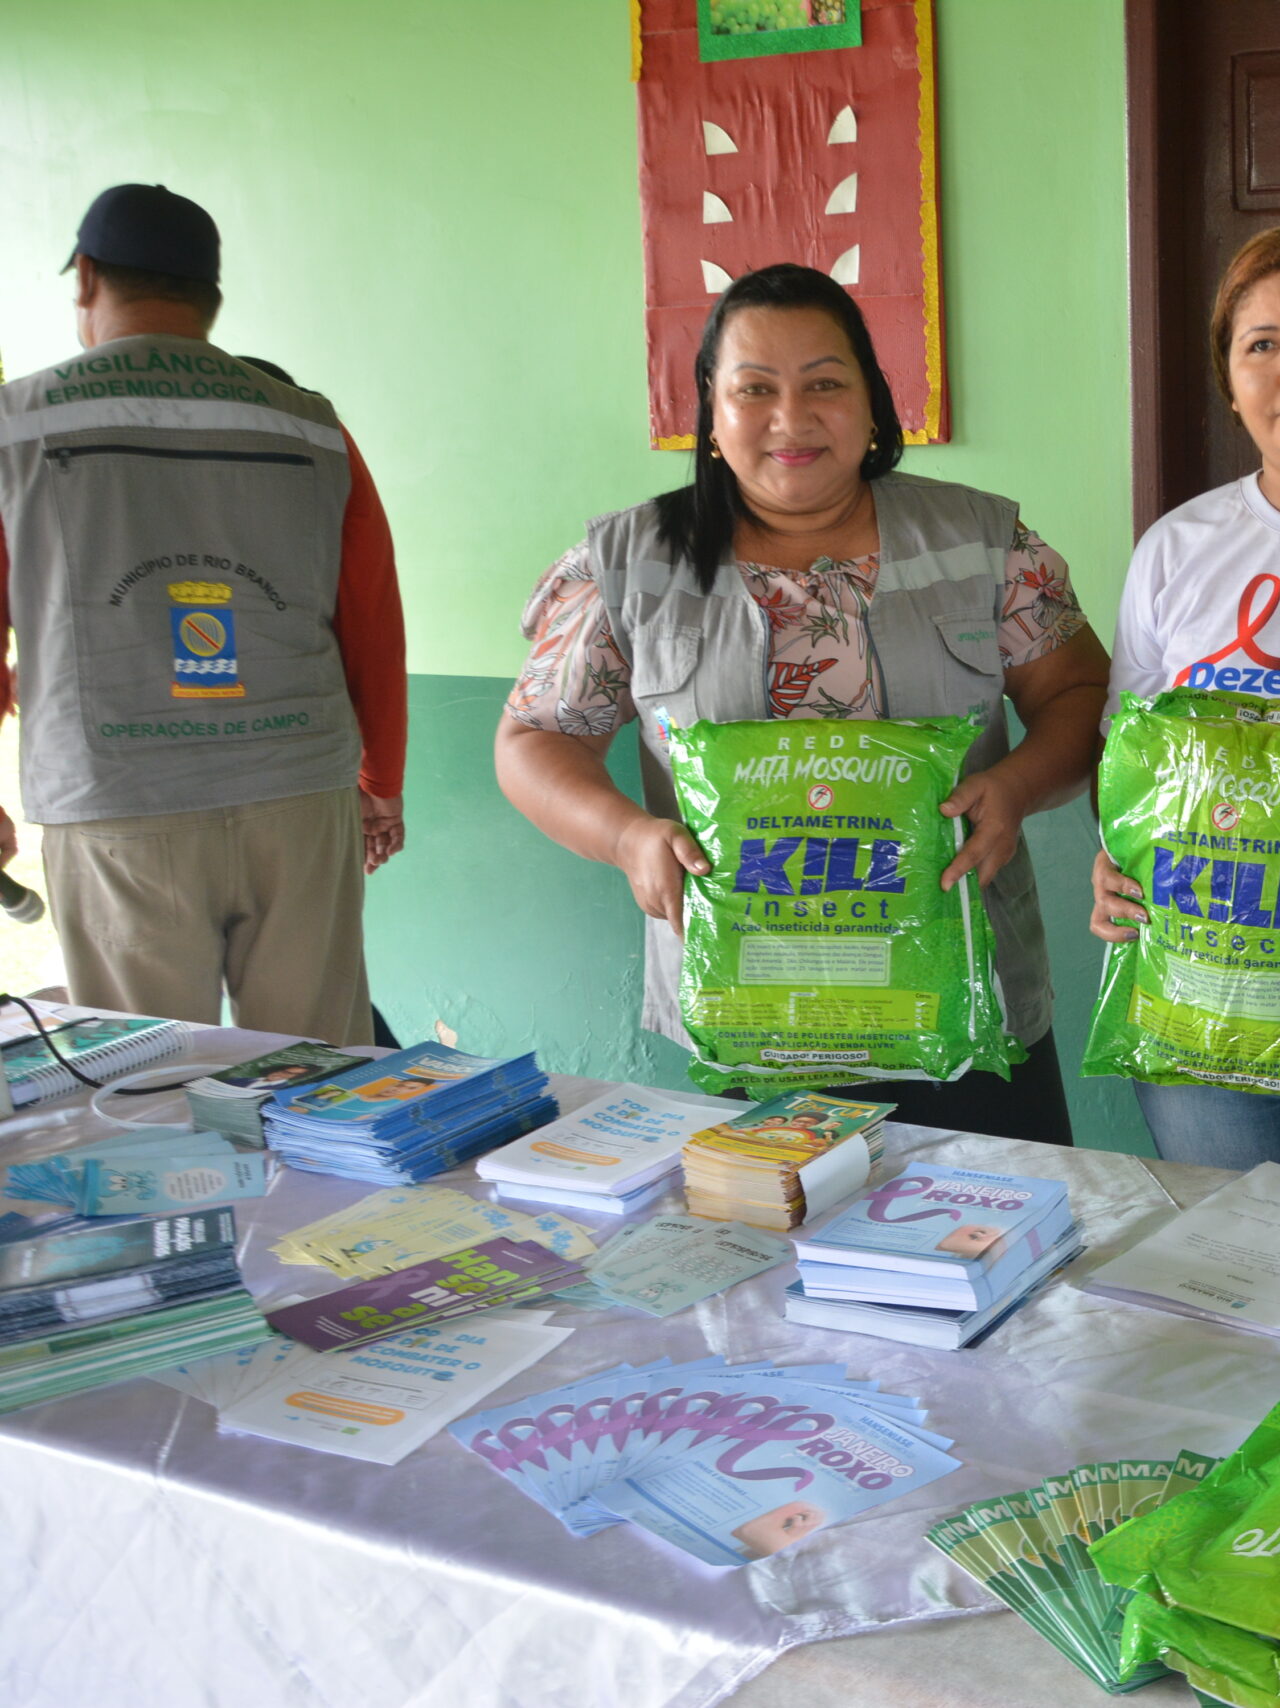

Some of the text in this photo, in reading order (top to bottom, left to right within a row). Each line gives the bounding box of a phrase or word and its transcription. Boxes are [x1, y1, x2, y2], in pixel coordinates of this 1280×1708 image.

[54, 348, 250, 381] VIGILÂNCIA
[46, 380, 270, 406] EPIDEMIOLÓGICA
[109, 553, 286, 612] MUNICÍPIO DE RIO BRANCO
[100, 712, 310, 740] OPERAÇÕES DE CAMPO
[777, 734, 872, 752] REDE
[733, 750, 913, 786] MATA MOSQUITO
[746, 815, 895, 832] DELTAMETRINA
[744, 895, 890, 919] insect
[765, 921, 830, 933] inseticida
[856, 1032, 911, 1042] INSETICIDA
[811, 1050, 868, 1061] PERIGOSO!
[920, 1190, 1025, 1211] ROXO
[932, 1180, 1033, 1201] JANEIRO
[439, 1249, 521, 1286] Han
[435, 1273, 490, 1295] se
[339, 1305, 395, 1329] se
[455, 1334, 487, 1345] DIA
[368, 1345, 482, 1371] COMBATER O
[822, 1426, 918, 1479] JANEIRO
[796, 1439, 894, 1492] ROXO
